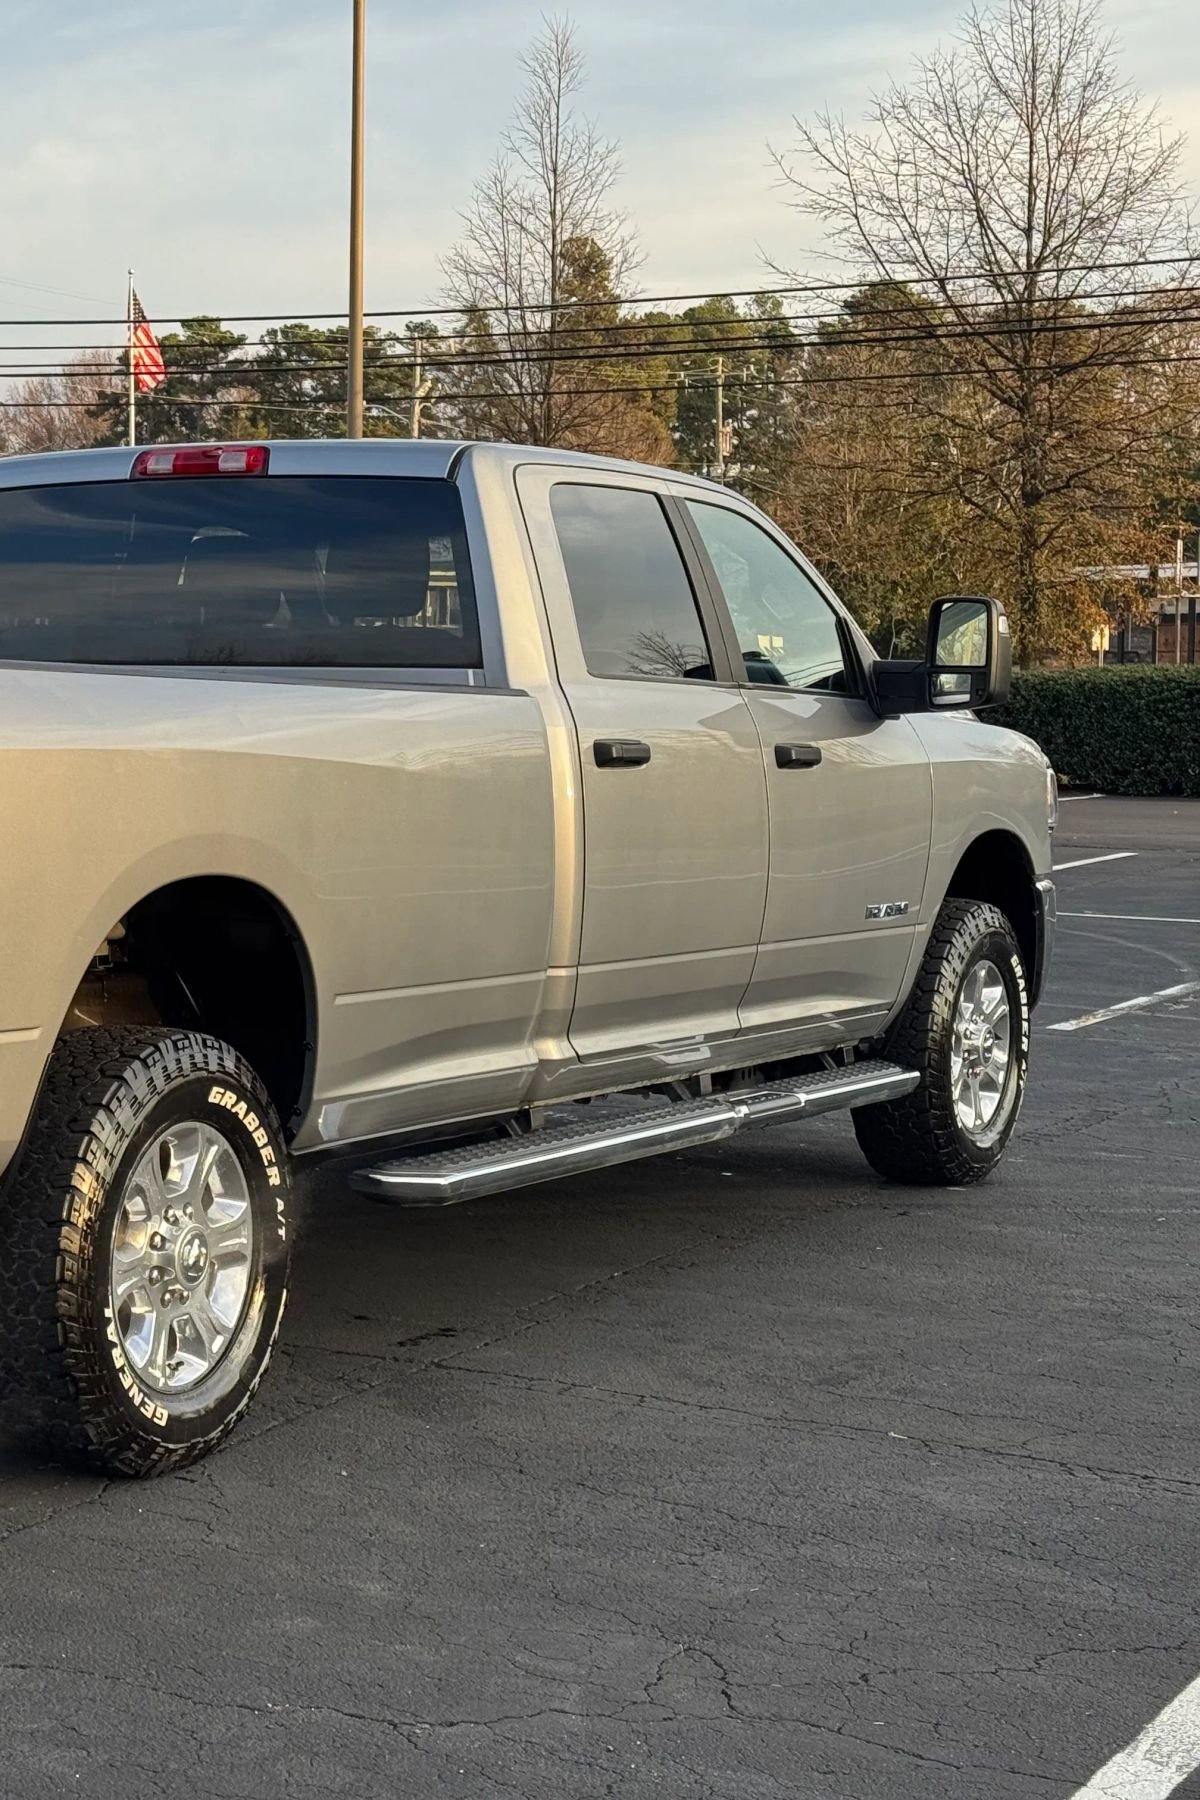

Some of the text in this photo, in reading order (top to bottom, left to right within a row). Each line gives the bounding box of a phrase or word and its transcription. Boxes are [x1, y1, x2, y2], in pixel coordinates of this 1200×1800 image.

[864, 901, 909, 920] RAM
[1010, 953, 1029, 1053] GRABBER
[208, 1086, 281, 1187] GRABBER
[104, 1295, 169, 1427] GENERAL
